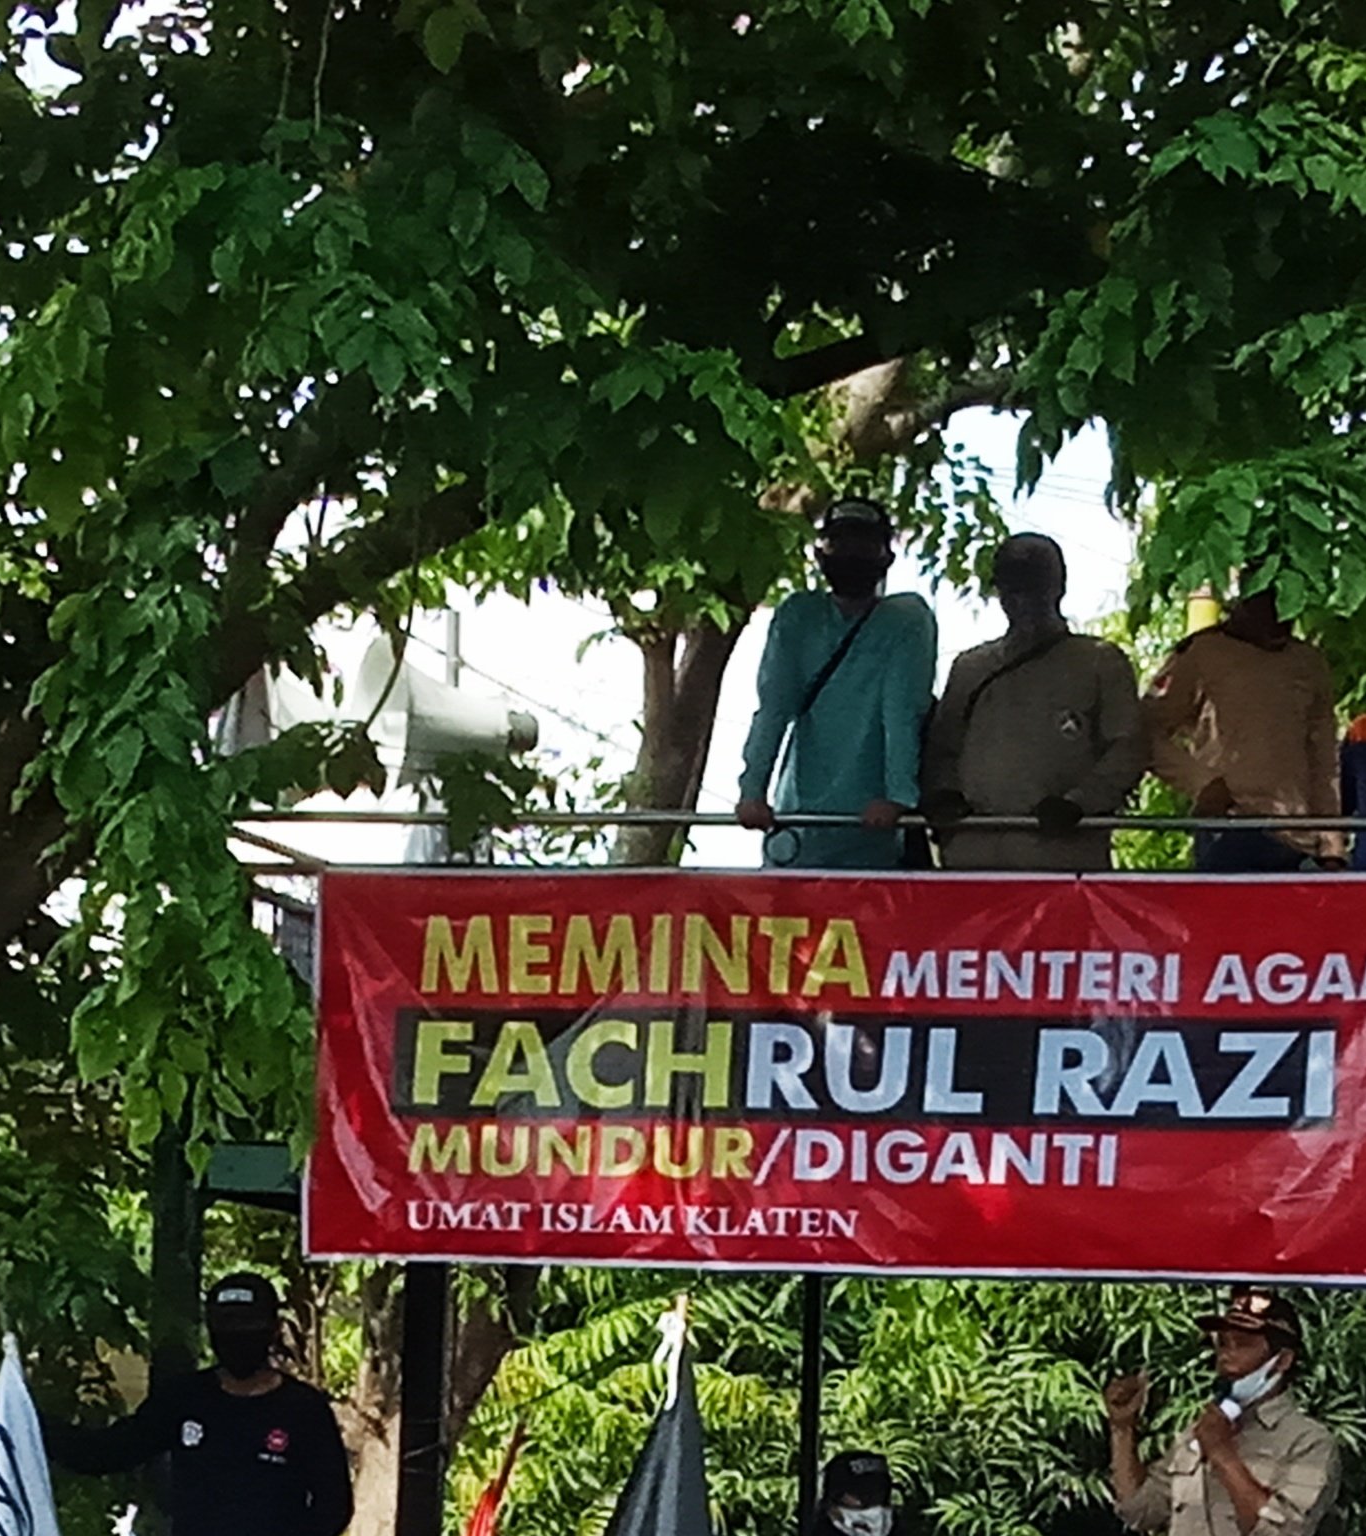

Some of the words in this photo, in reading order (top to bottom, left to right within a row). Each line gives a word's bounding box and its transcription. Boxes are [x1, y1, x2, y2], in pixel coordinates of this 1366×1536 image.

[420, 914, 872, 998] MEMINTA
[880, 950, 1180, 1003] MENTERI
[411, 1020, 985, 1117] FACHRUL
[1033, 1025, 1338, 1120] RAZI
[407, 1122, 1118, 1188] MUNDUR/DIGANTI
[407, 1201, 532, 1235] UMAT
[541, 1203, 674, 1237] ISLAM
[684, 1205, 859, 1241] KLATEN
